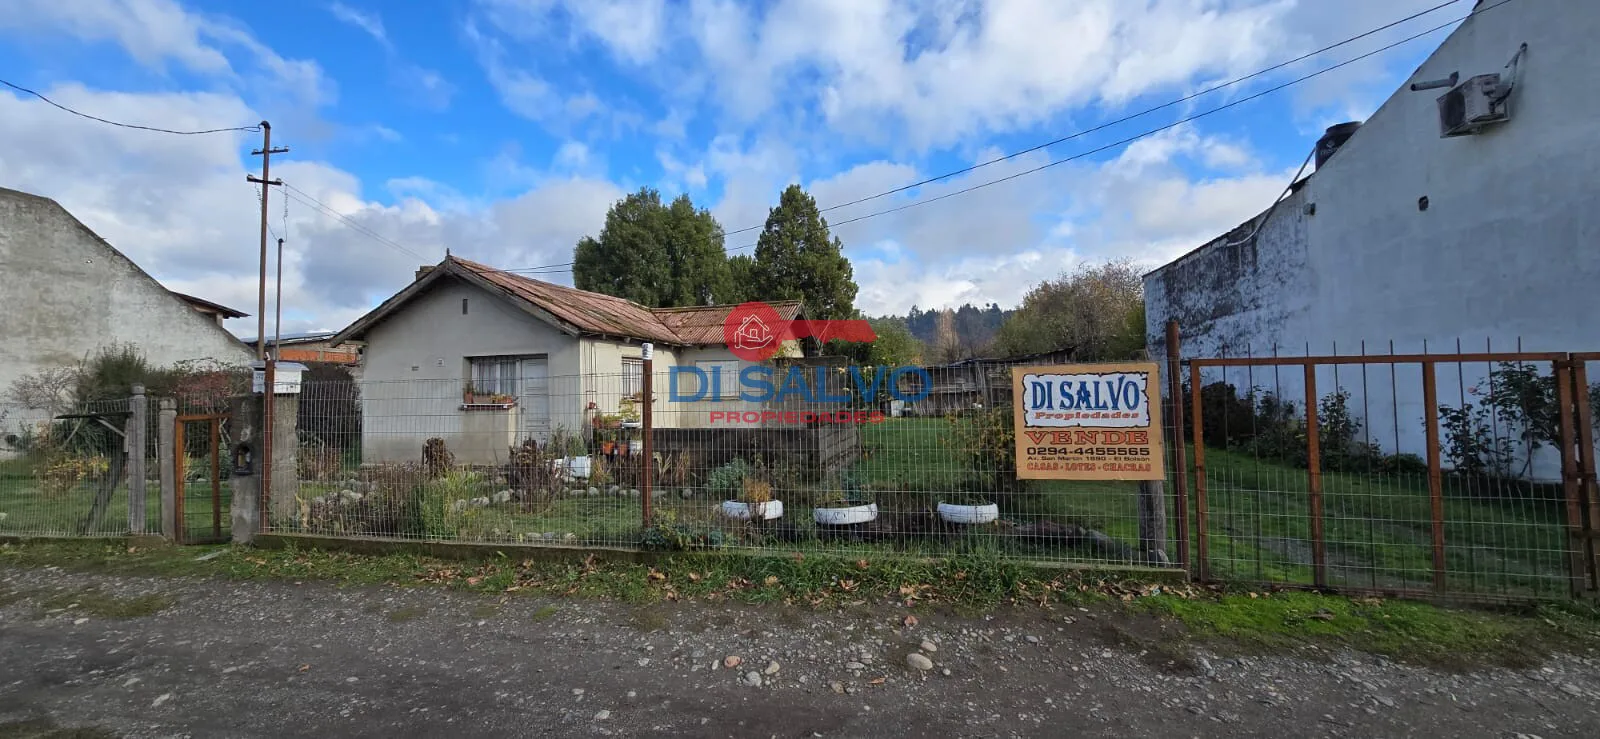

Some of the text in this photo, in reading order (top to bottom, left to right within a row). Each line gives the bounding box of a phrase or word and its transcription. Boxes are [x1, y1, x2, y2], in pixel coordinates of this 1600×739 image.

[1031, 375, 1140, 410] DI SALVO
[1034, 411, 1140, 420] Propiedades
[1024, 430, 1149, 445] VENDE
[1026, 447, 1150, 456] 0294-4455565
[1027, 462, 1059, 471] CASAS
[1065, 462, 1096, 471] LOTES
[1102, 463, 1151, 472] CHACRAS
